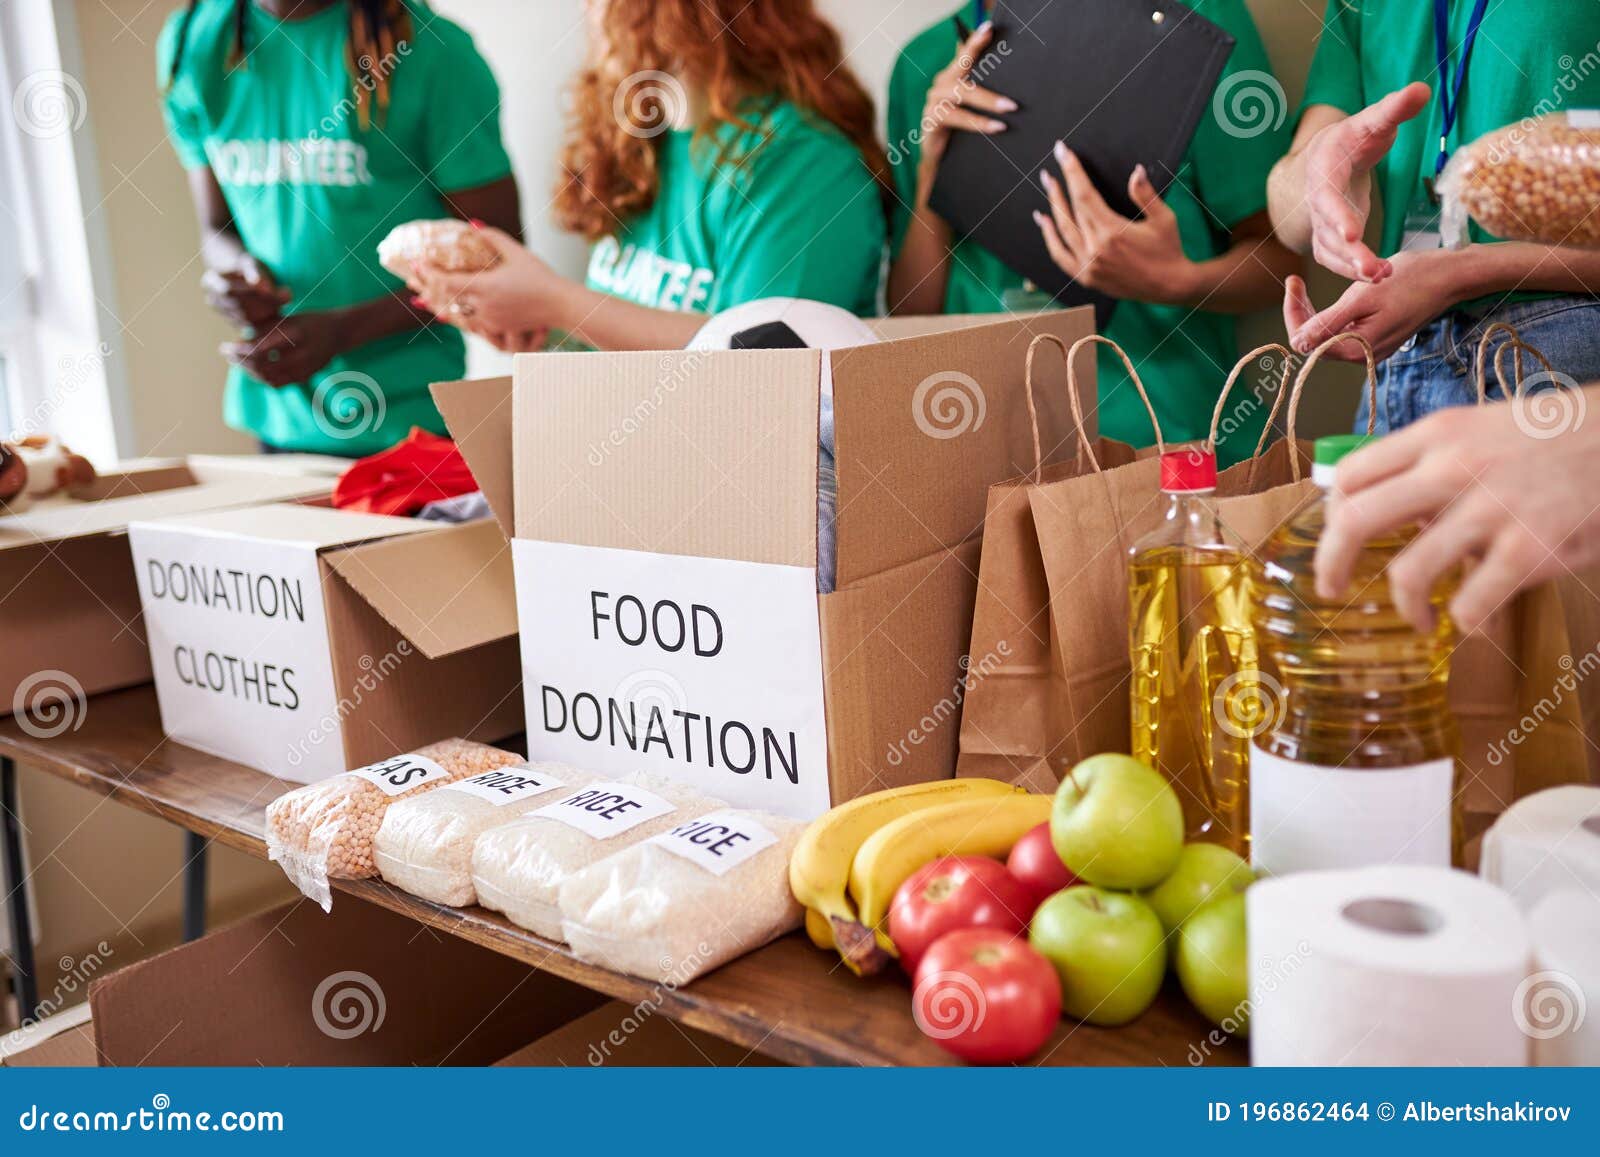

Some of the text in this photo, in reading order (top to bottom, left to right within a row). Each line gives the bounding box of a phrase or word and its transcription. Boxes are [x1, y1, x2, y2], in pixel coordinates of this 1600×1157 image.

[148, 560, 304, 622] DONATION
[591, 590, 724, 658] FOOD
[174, 645, 299, 710] CLOTHES
[542, 684, 799, 785] DONATION
[465, 771, 541, 794] RICE
[560, 789, 642, 820] RICE
